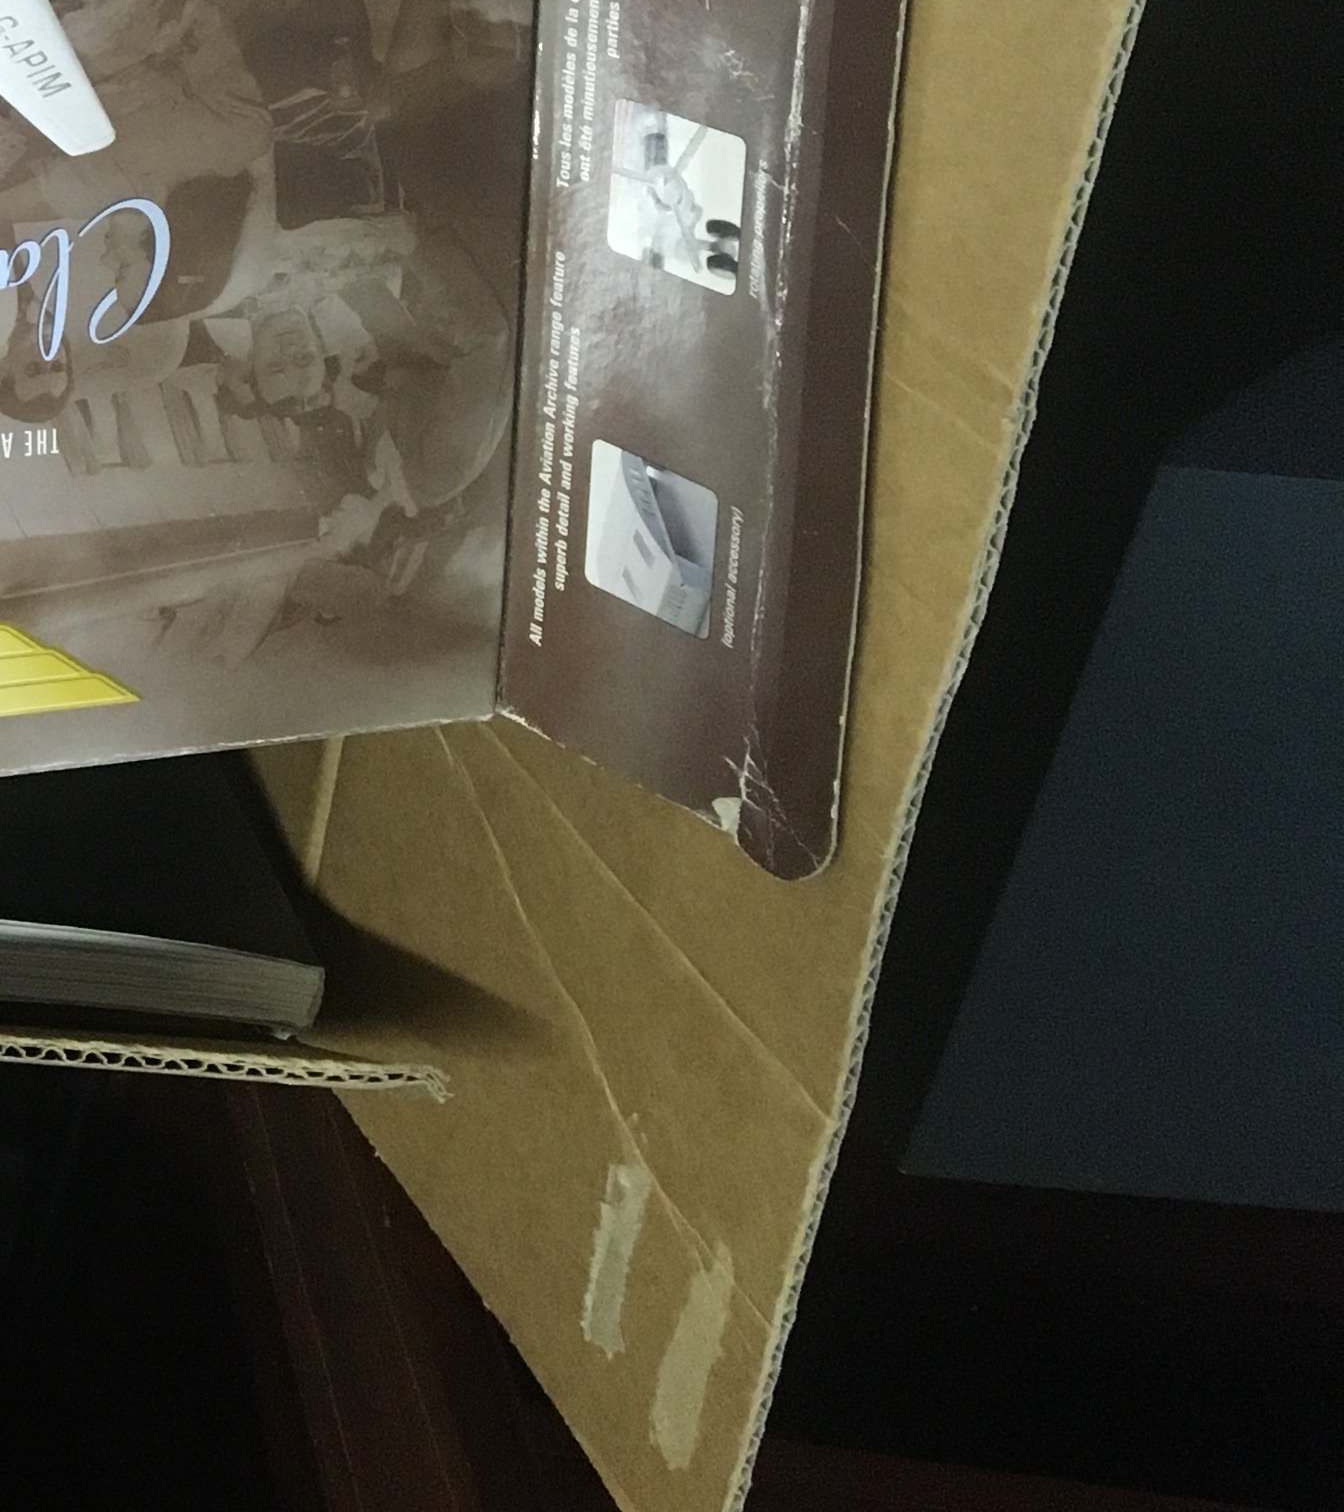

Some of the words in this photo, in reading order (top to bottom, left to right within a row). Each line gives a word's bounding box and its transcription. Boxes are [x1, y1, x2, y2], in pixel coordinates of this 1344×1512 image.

[564, 31, 579, 48] de
[565, 7, 580, 24] la
[606, 1, 621, 59] parties
[562, 51, 577, 120] modèles
[559, 124, 572, 148] les
[556, 152, 572, 188] Tous
[579, 156, 591, 182] ont
[549, 251, 566, 307] feature
[549, 310, 564, 355] range
[564, 326, 581, 392] features
[543, 357, 560, 420] Archive
[23, 428, 60, 457] THE
[561, 394, 579, 457] working
[538, 422, 555, 486] Aviation
[560, 459, 572, 490] and
[537, 488, 551, 514] the
[555, 492, 570, 537] detail
[534, 516, 549, 565] within
[554, 538, 569, 592] superb
[727, 505, 745, 584] accessory)
[532, 567, 547, 624] models
[720, 582, 737, 650] (optional
[529, 623, 543, 647] All
